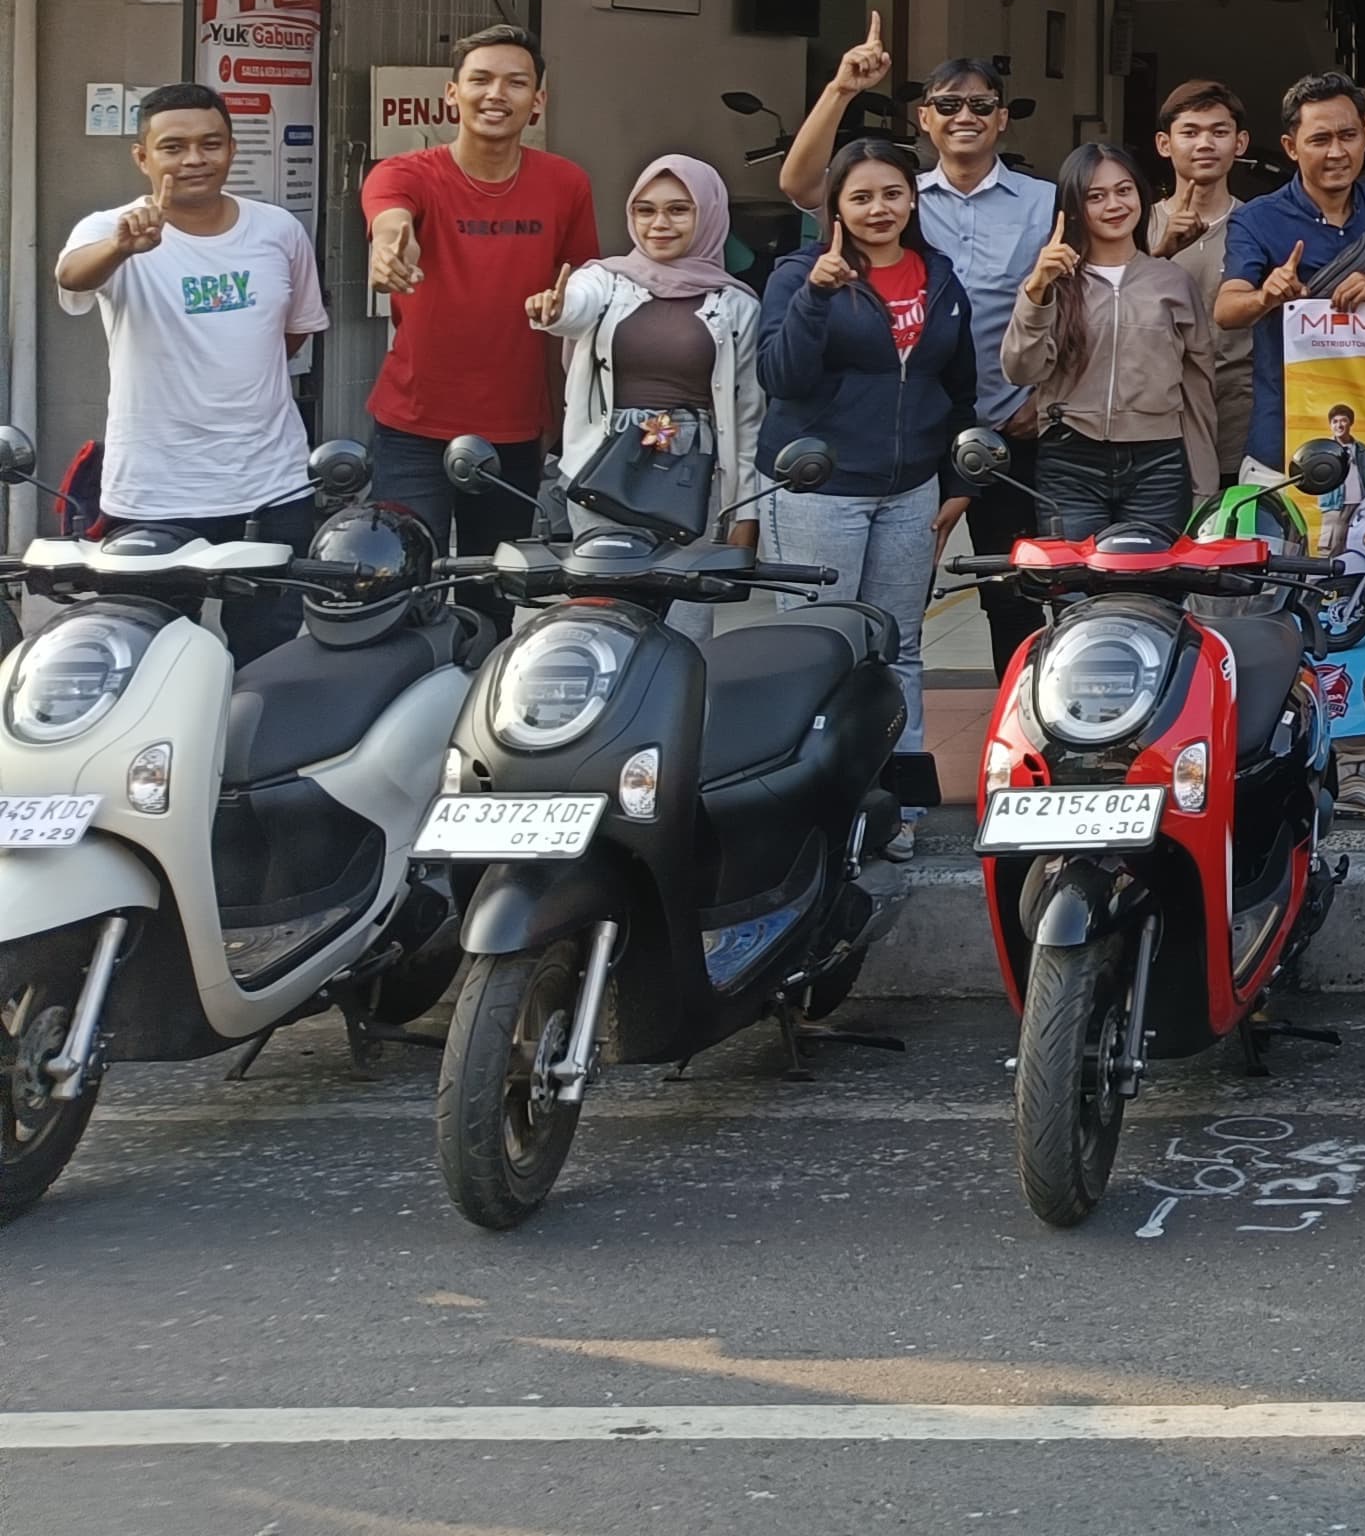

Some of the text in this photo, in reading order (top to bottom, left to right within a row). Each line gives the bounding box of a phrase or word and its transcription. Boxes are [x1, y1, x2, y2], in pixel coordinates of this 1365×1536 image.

[209, 22, 315, 54] Yuk Gabung
[41, 800, 95, 820] KDC
[436, 802, 597, 824] AG 3372 KDF
[995, 795, 1034, 817] AG
[1037, 795, 1098, 817] 2154
